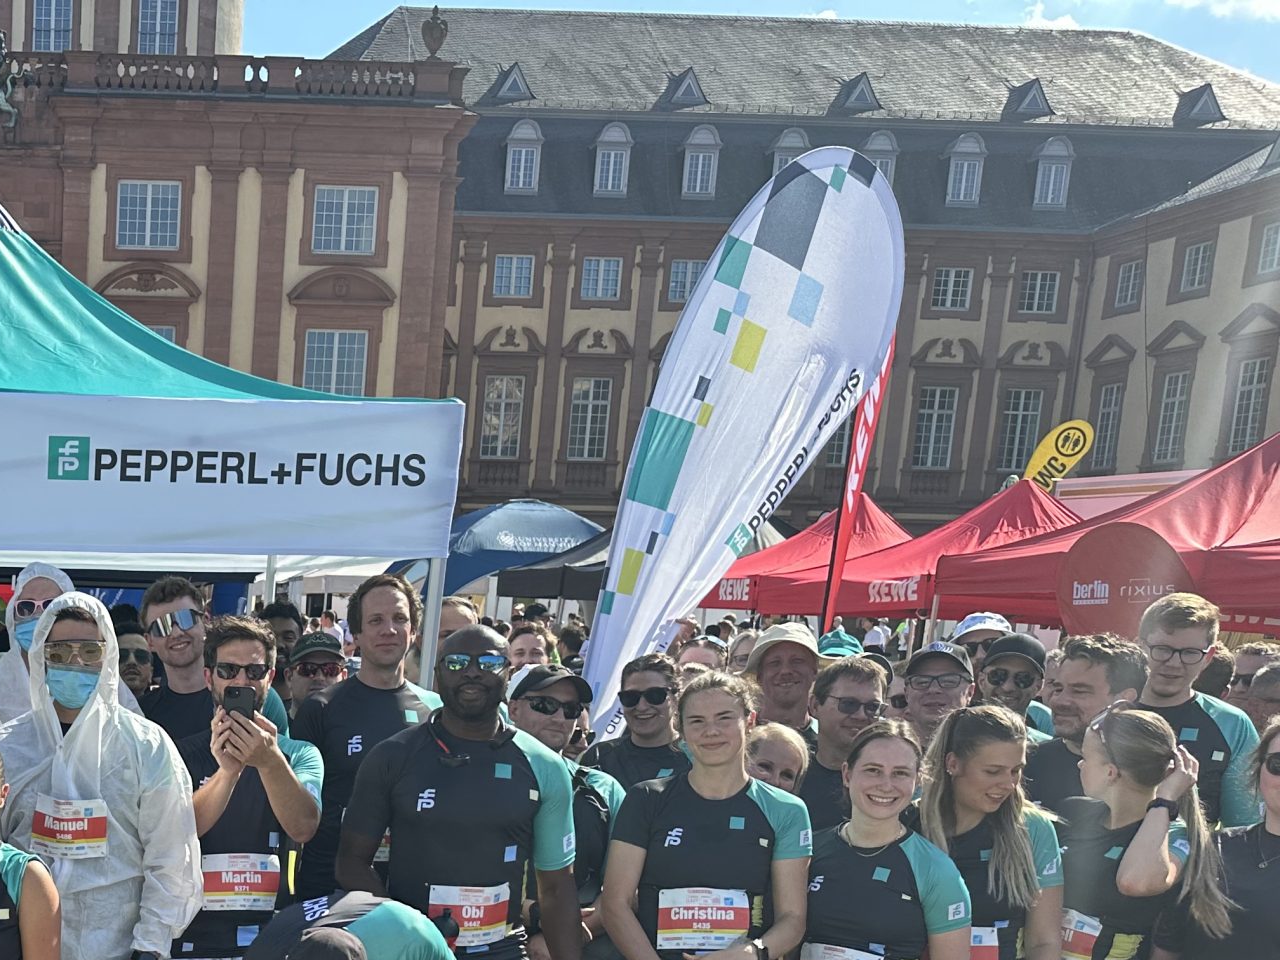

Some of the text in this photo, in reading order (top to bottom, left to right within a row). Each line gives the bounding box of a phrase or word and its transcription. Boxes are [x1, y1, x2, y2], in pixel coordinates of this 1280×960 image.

[94, 448, 427, 487] PEPPERL+FUCHS
[1032, 456, 1067, 489] WC
[719, 578, 750, 601] REWE
[869, 576, 921, 603] REWE
[1073, 580, 1109, 599] berlin
[1120, 582, 1175, 598] rixius
[44, 815, 88, 831] Manuel
[221, 871, 262, 884] Martin
[461, 905, 485, 919] Obi
[670, 907, 735, 921] Christina
